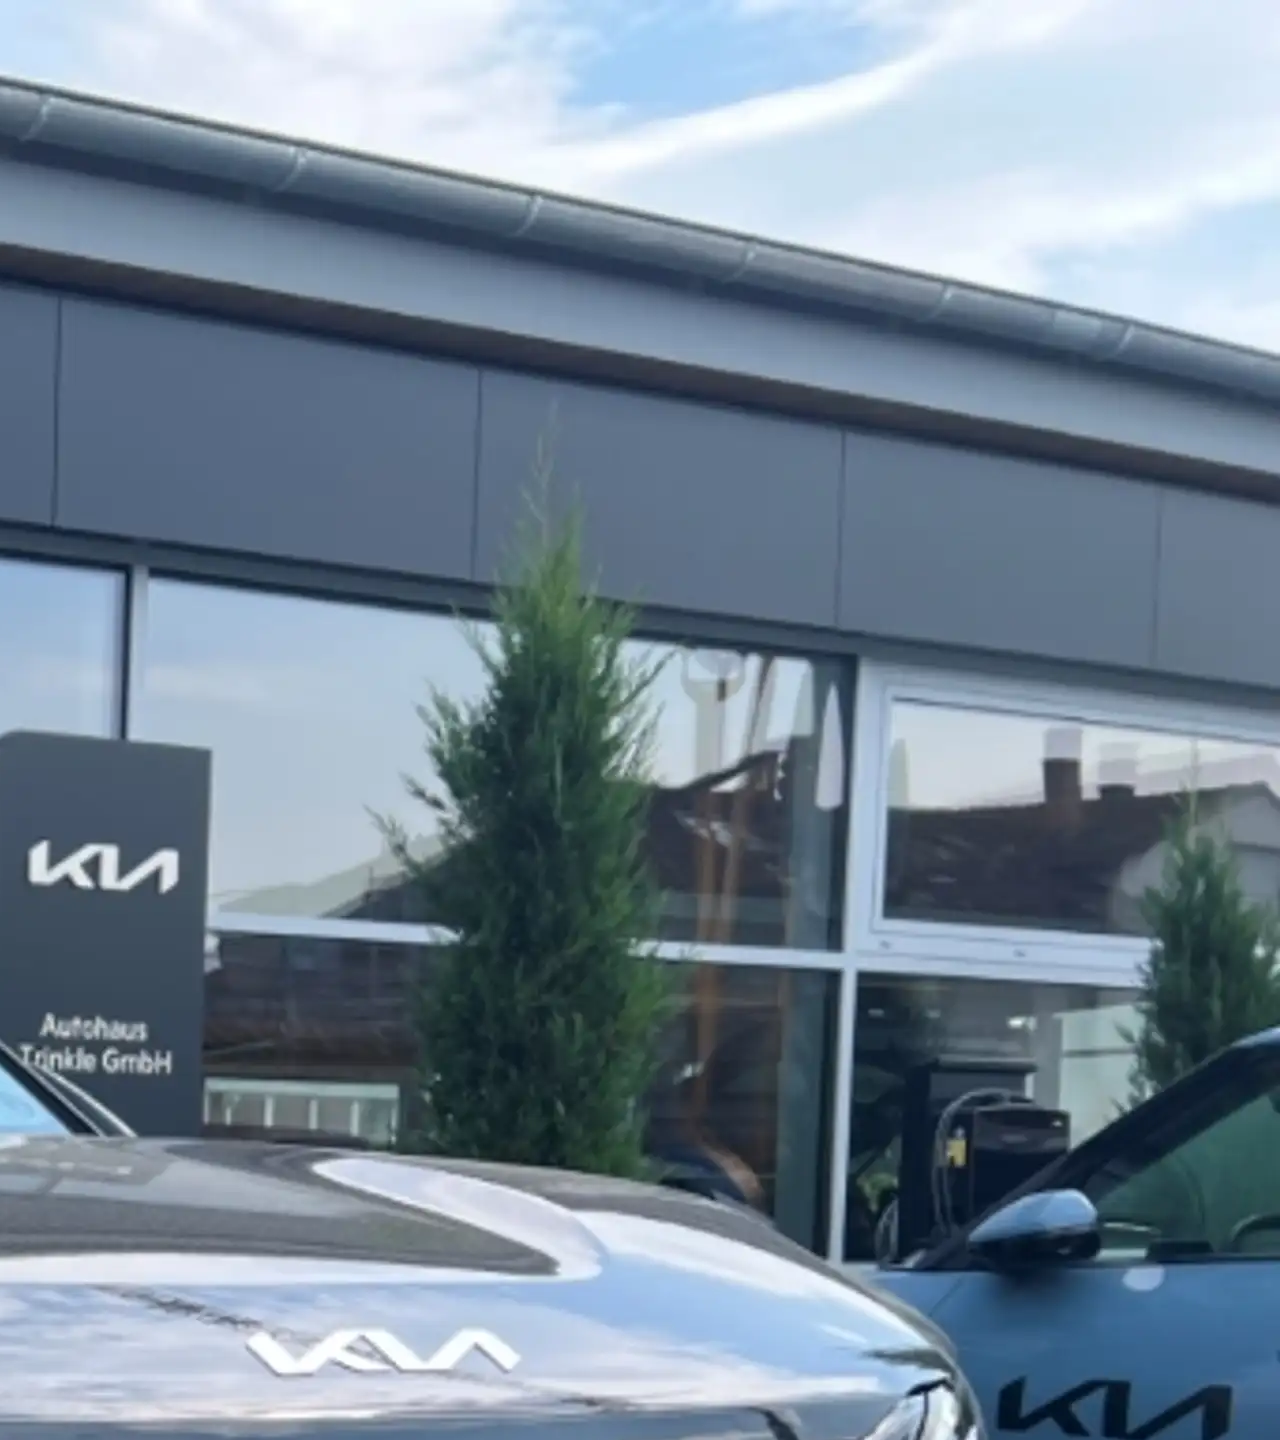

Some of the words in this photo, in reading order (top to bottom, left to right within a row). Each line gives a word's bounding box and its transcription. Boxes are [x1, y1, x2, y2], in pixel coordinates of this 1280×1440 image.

[28, 839, 180, 894] KIA
[39, 1012, 149, 1042] Autohaus
[19, 1043, 97, 1074] Trinkle
[101, 1047, 173, 1076] GmbH
[244, 1328, 522, 1377] KIA
